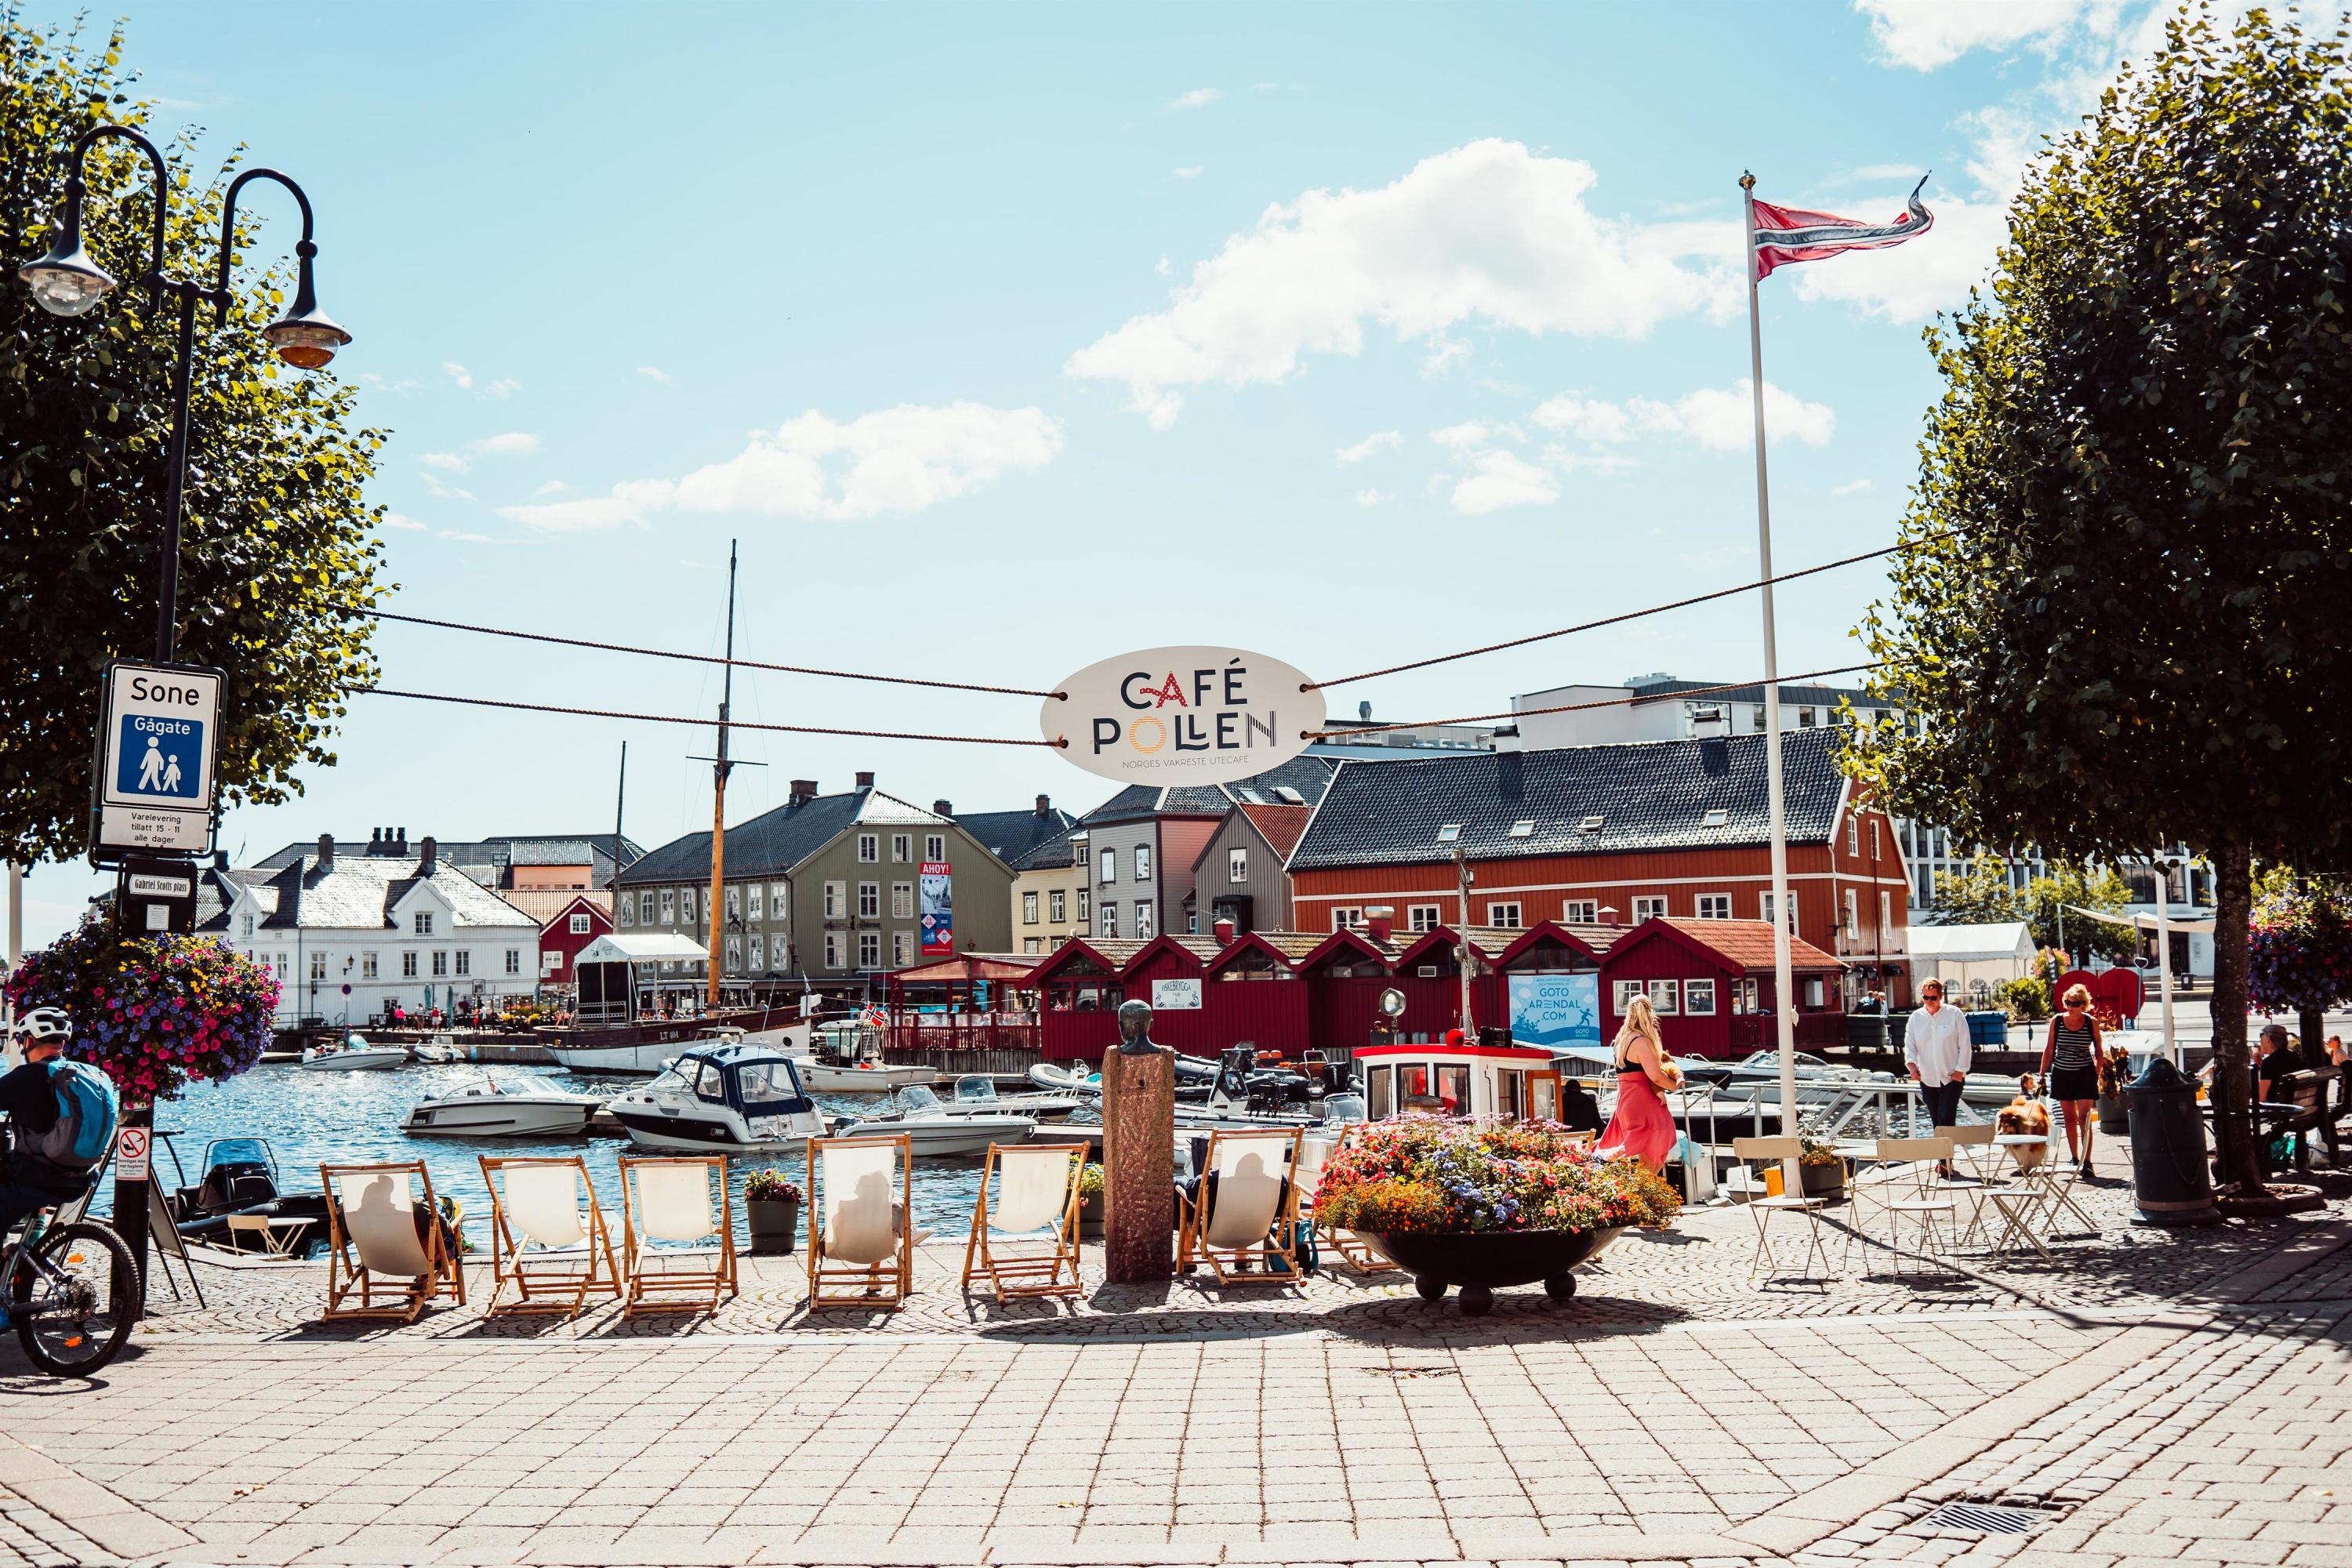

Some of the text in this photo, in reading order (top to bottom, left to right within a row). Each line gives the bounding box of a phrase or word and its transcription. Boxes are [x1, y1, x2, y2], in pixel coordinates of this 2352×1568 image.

[1120, 657, 1247, 710] CAFÉ
[130, 677, 200, 706] Sone
[134, 717, 191, 735] Gågate
[1093, 710, 1277, 755] POLLEN
[1122, 759, 1160, 769] NORGES
[1163, 757, 1207, 767] VAKRESTE
[131, 812, 181, 824] Varelevering
[131, 823, 152, 832] tillatt
[151, 835, 175, 844] dager
[923, 864, 949, 874] AHOY!
[135, 879, 155, 890] Gabriel
[173, 882, 187, 893] plass
[1540, 988, 1569, 997] GOTO
[1529, 1000, 1581, 1009] ARENDAL
[1541, 1011, 1566, 1021] .COM
[659, 1031, 669, 1040] LT
